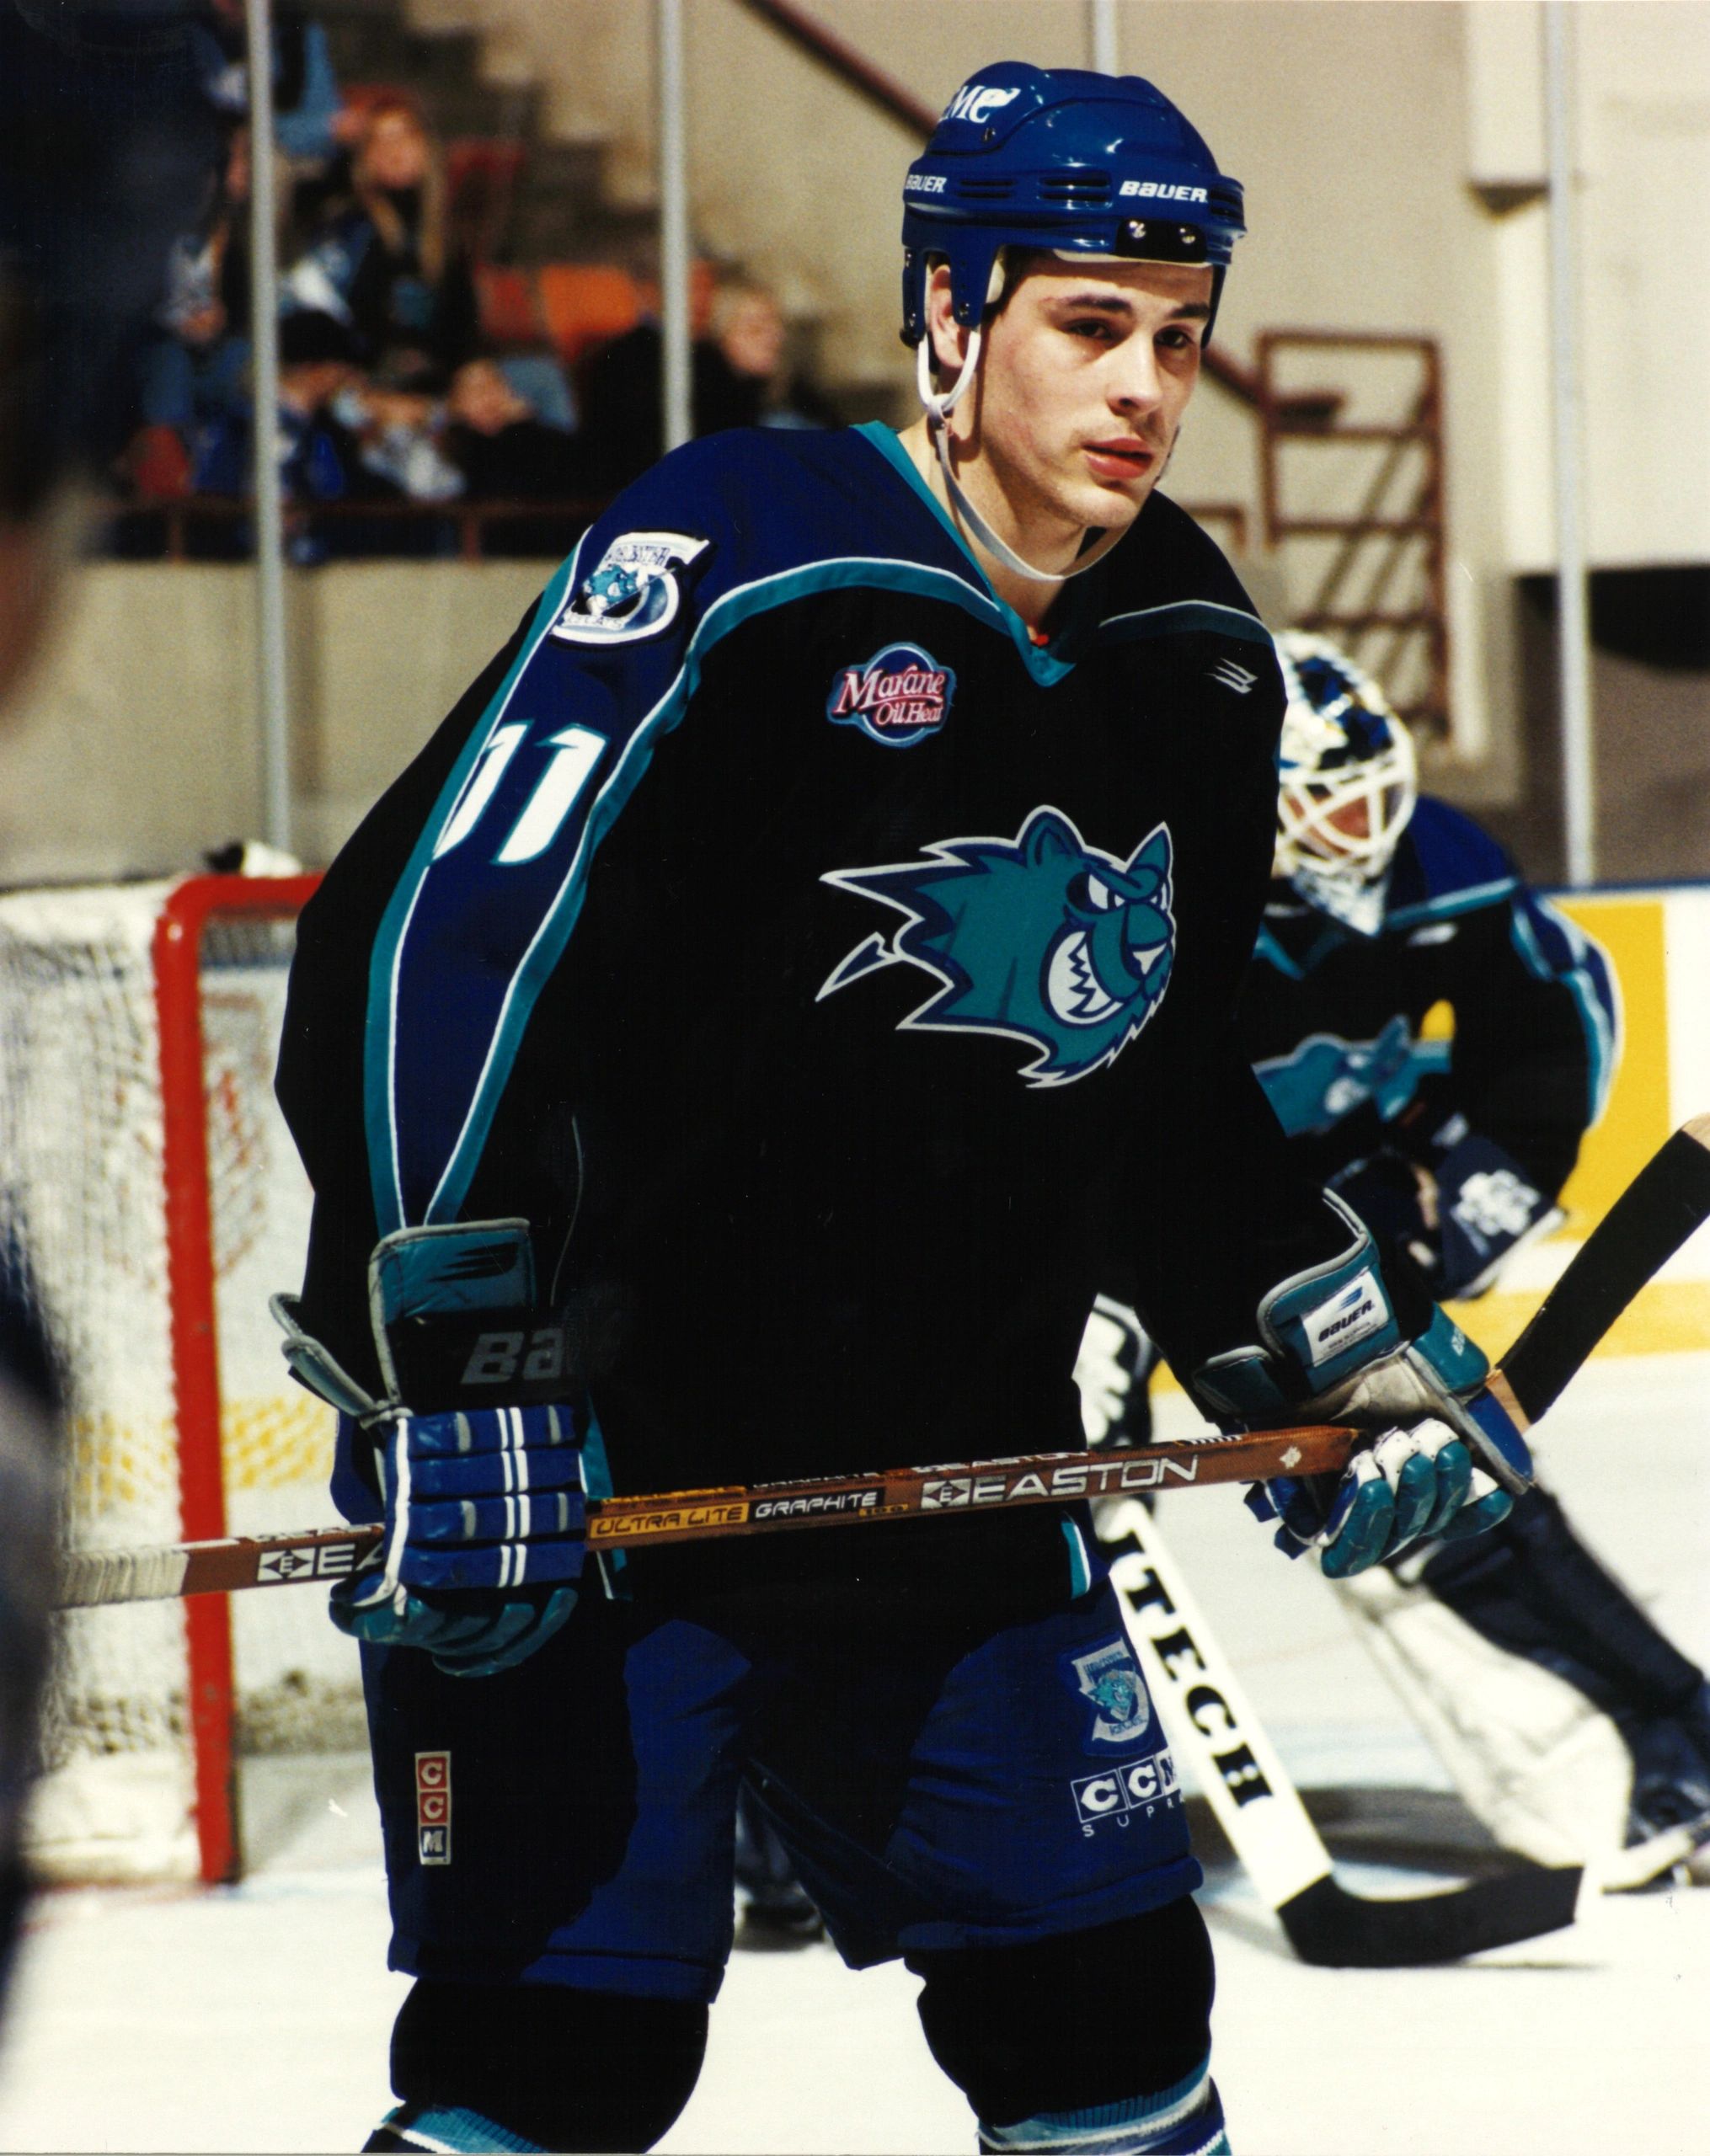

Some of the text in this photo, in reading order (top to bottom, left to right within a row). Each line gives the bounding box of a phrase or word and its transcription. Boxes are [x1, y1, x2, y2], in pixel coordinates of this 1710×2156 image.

[874, 701, 906, 726] Oil
[430, 719, 611, 867] 11
[971, 1454, 1199, 1505] EASTON
[595, 1504, 743, 1536] ULTRA LITE
[754, 1491, 878, 1518] GRAPHITE
[419, 1758, 446, 1855] CCM
